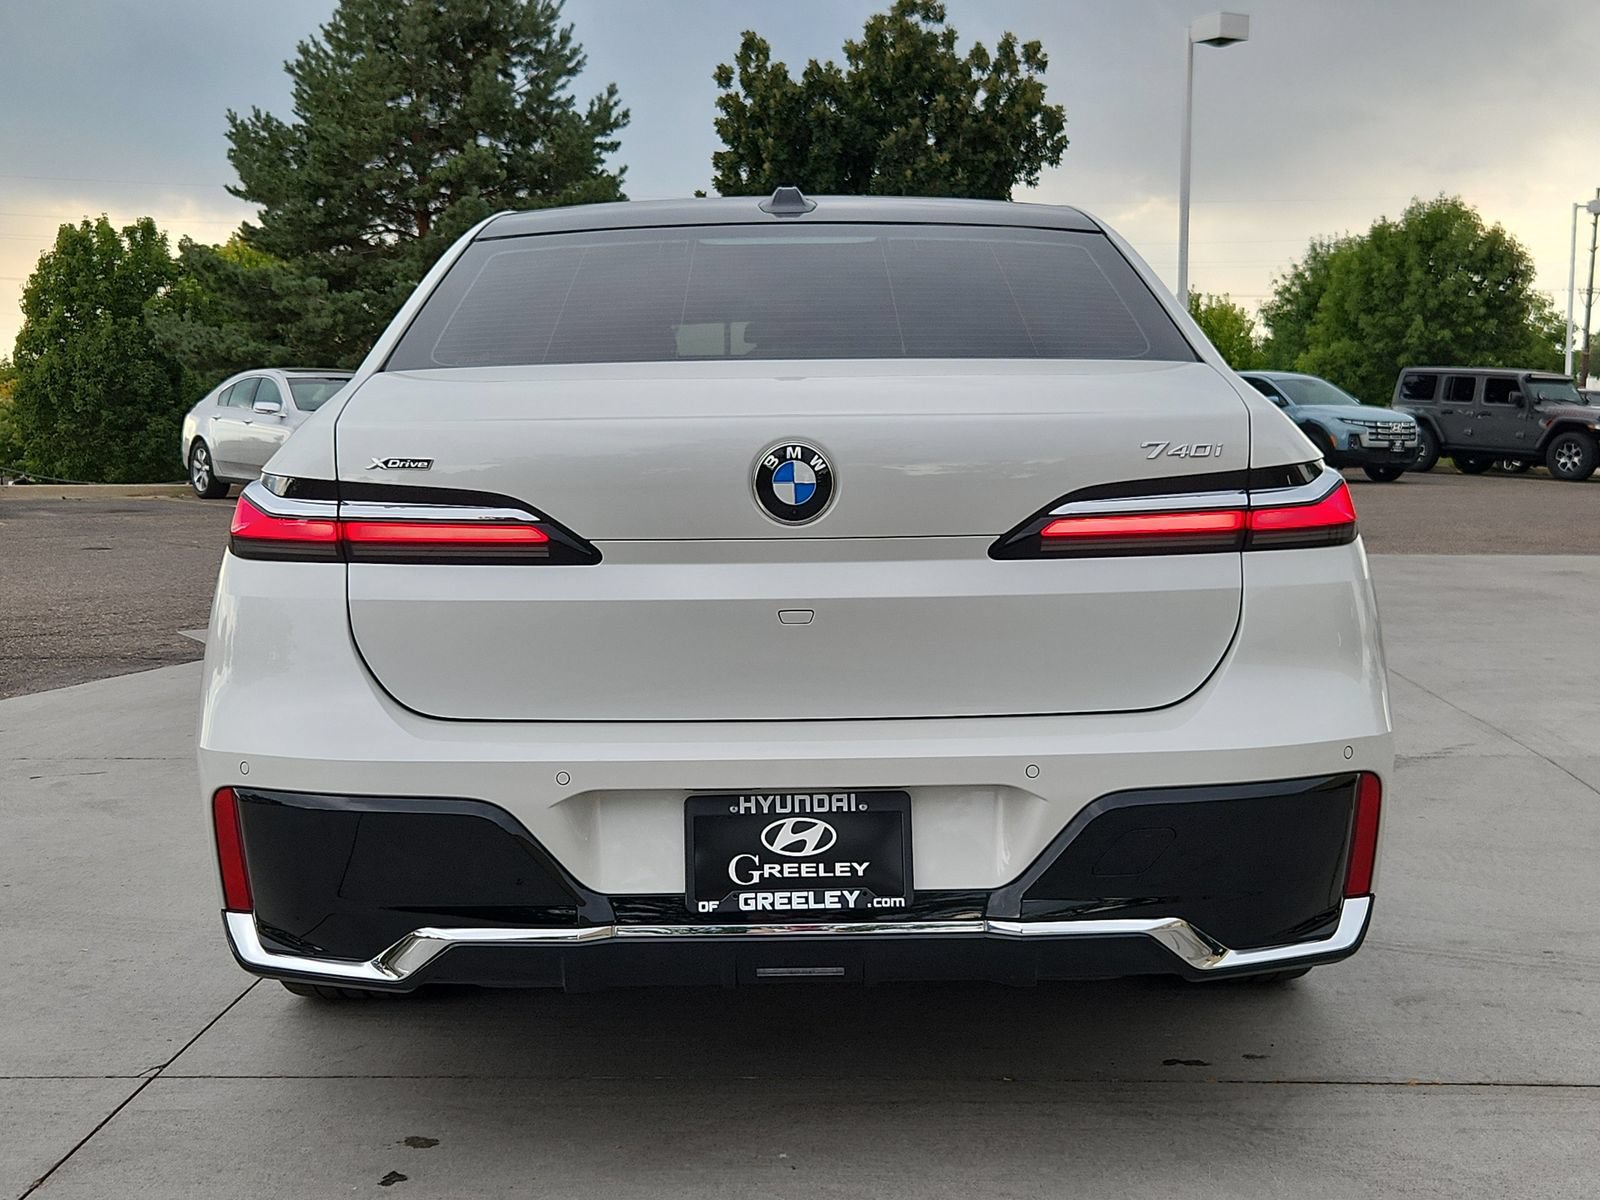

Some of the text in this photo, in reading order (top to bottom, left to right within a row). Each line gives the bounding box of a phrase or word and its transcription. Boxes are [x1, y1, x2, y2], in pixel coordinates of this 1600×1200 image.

[763, 446, 826, 471] BMW
[1140, 441, 1223, 460] 740i
[739, 793, 857, 814] HYUNDAI
[698, 901, 720, 912] OF
[738, 890, 861, 911] GREELEY
